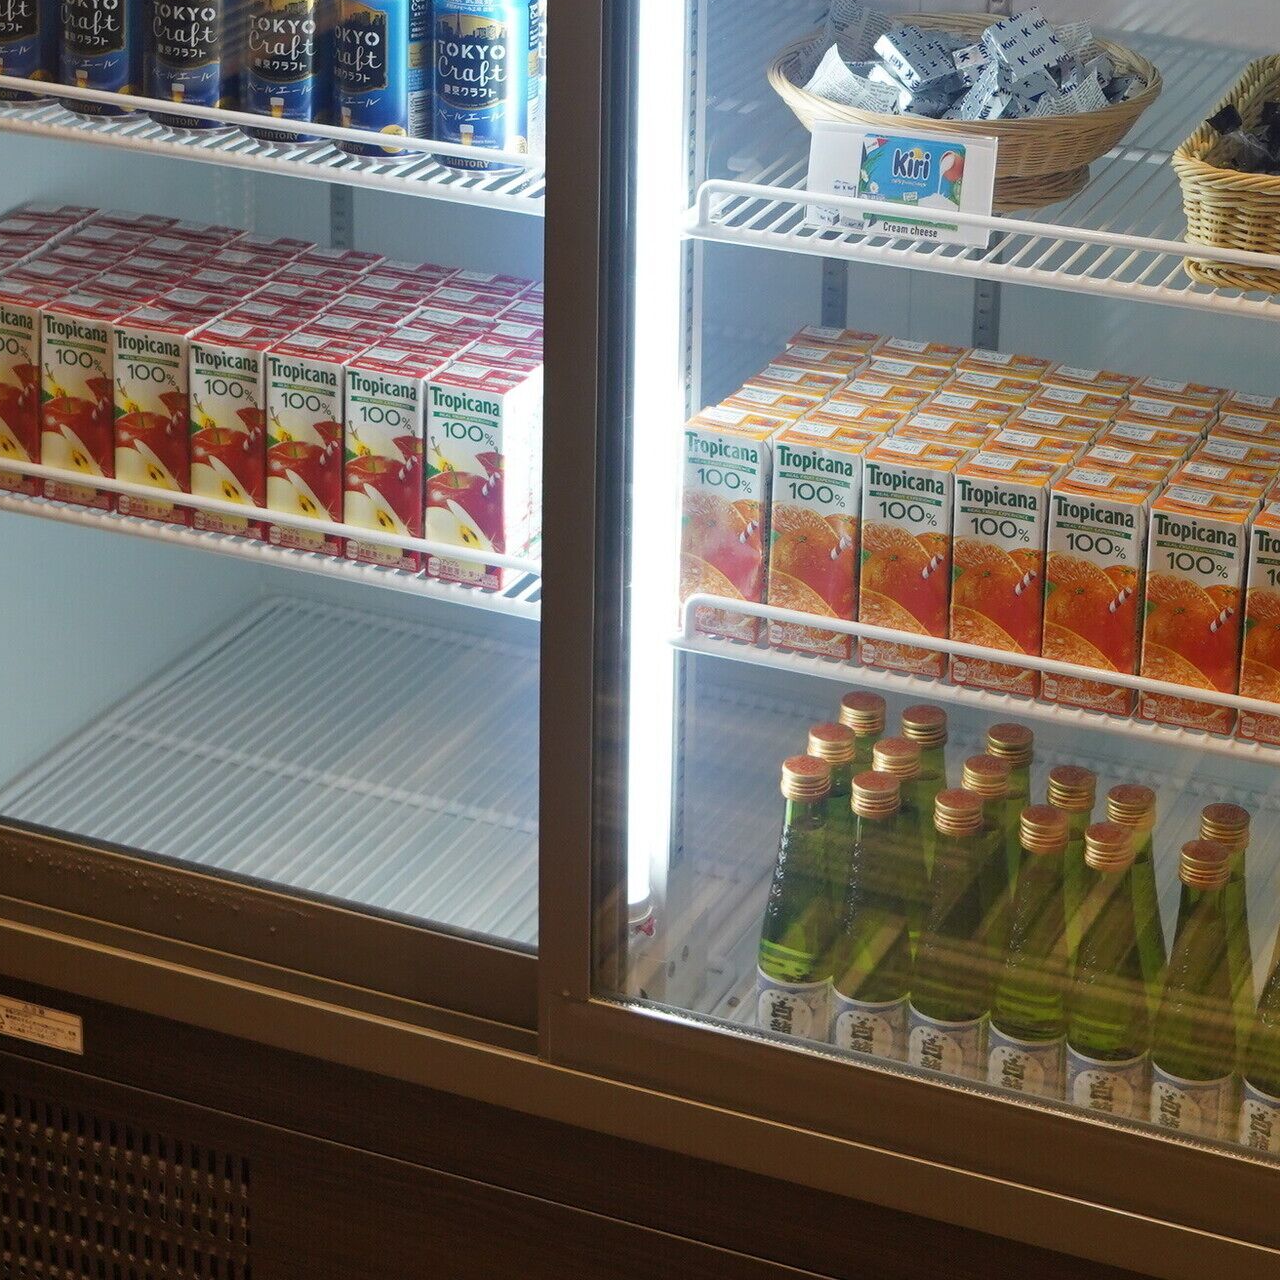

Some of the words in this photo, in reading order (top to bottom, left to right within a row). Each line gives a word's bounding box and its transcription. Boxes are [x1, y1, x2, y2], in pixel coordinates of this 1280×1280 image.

[153, 1, 216, 22] TOKYO
[249, 14, 316, 34] TOKYO
[1033, 17, 1048, 30] Kiri
[152, 17, 218, 47] Craft
[249, 30, 316, 60] Craft
[1002, 37, 1017, 50] Kiri
[438, 39, 506, 61] TOKYO
[1029, 45, 1045, 58] Kiri
[438, 56, 506, 86] Craft
[444, 83, 497, 97] 東京クラフト
[436, 108, 506, 121] ペールエール
[893, 149, 931, 179] Kiri
[883, 221, 909, 234] Cream
[910, 226, 938, 238] cheese
[43, 314, 107, 343] Tropicana
[114, 330, 181, 357] Tropicana
[56, 349, 103, 370] 100%
[191, 345, 259, 373] Tropicana
[268, 357, 338, 386] Tropicana
[128, 364, 175, 386] 100%
[348, 371, 417, 401] Tropicana
[204, 379, 254, 402] 100%
[281, 392, 331, 415] 100%
[430, 386, 500, 417] Tropicana
[360, 406, 412, 431] 100%
[442, 422, 494, 447] 100%
[685, 431, 758, 464] Tropicana
[776, 446, 853, 477] Tropicana
[697, 468, 752, 494] 100%
[866, 464, 944, 495] Tropicana
[789, 482, 846, 508] 100%
[957, 479, 1037, 510] Tropicana
[879, 501, 937, 526] 100%
[1054, 495, 1134, 528] Tropicana
[971, 517, 1030, 543] 100%
[1154, 514, 1237, 548] Tropicana
[1066, 533, 1126, 560] 100%
[1167, 551, 1228, 579] 100%
